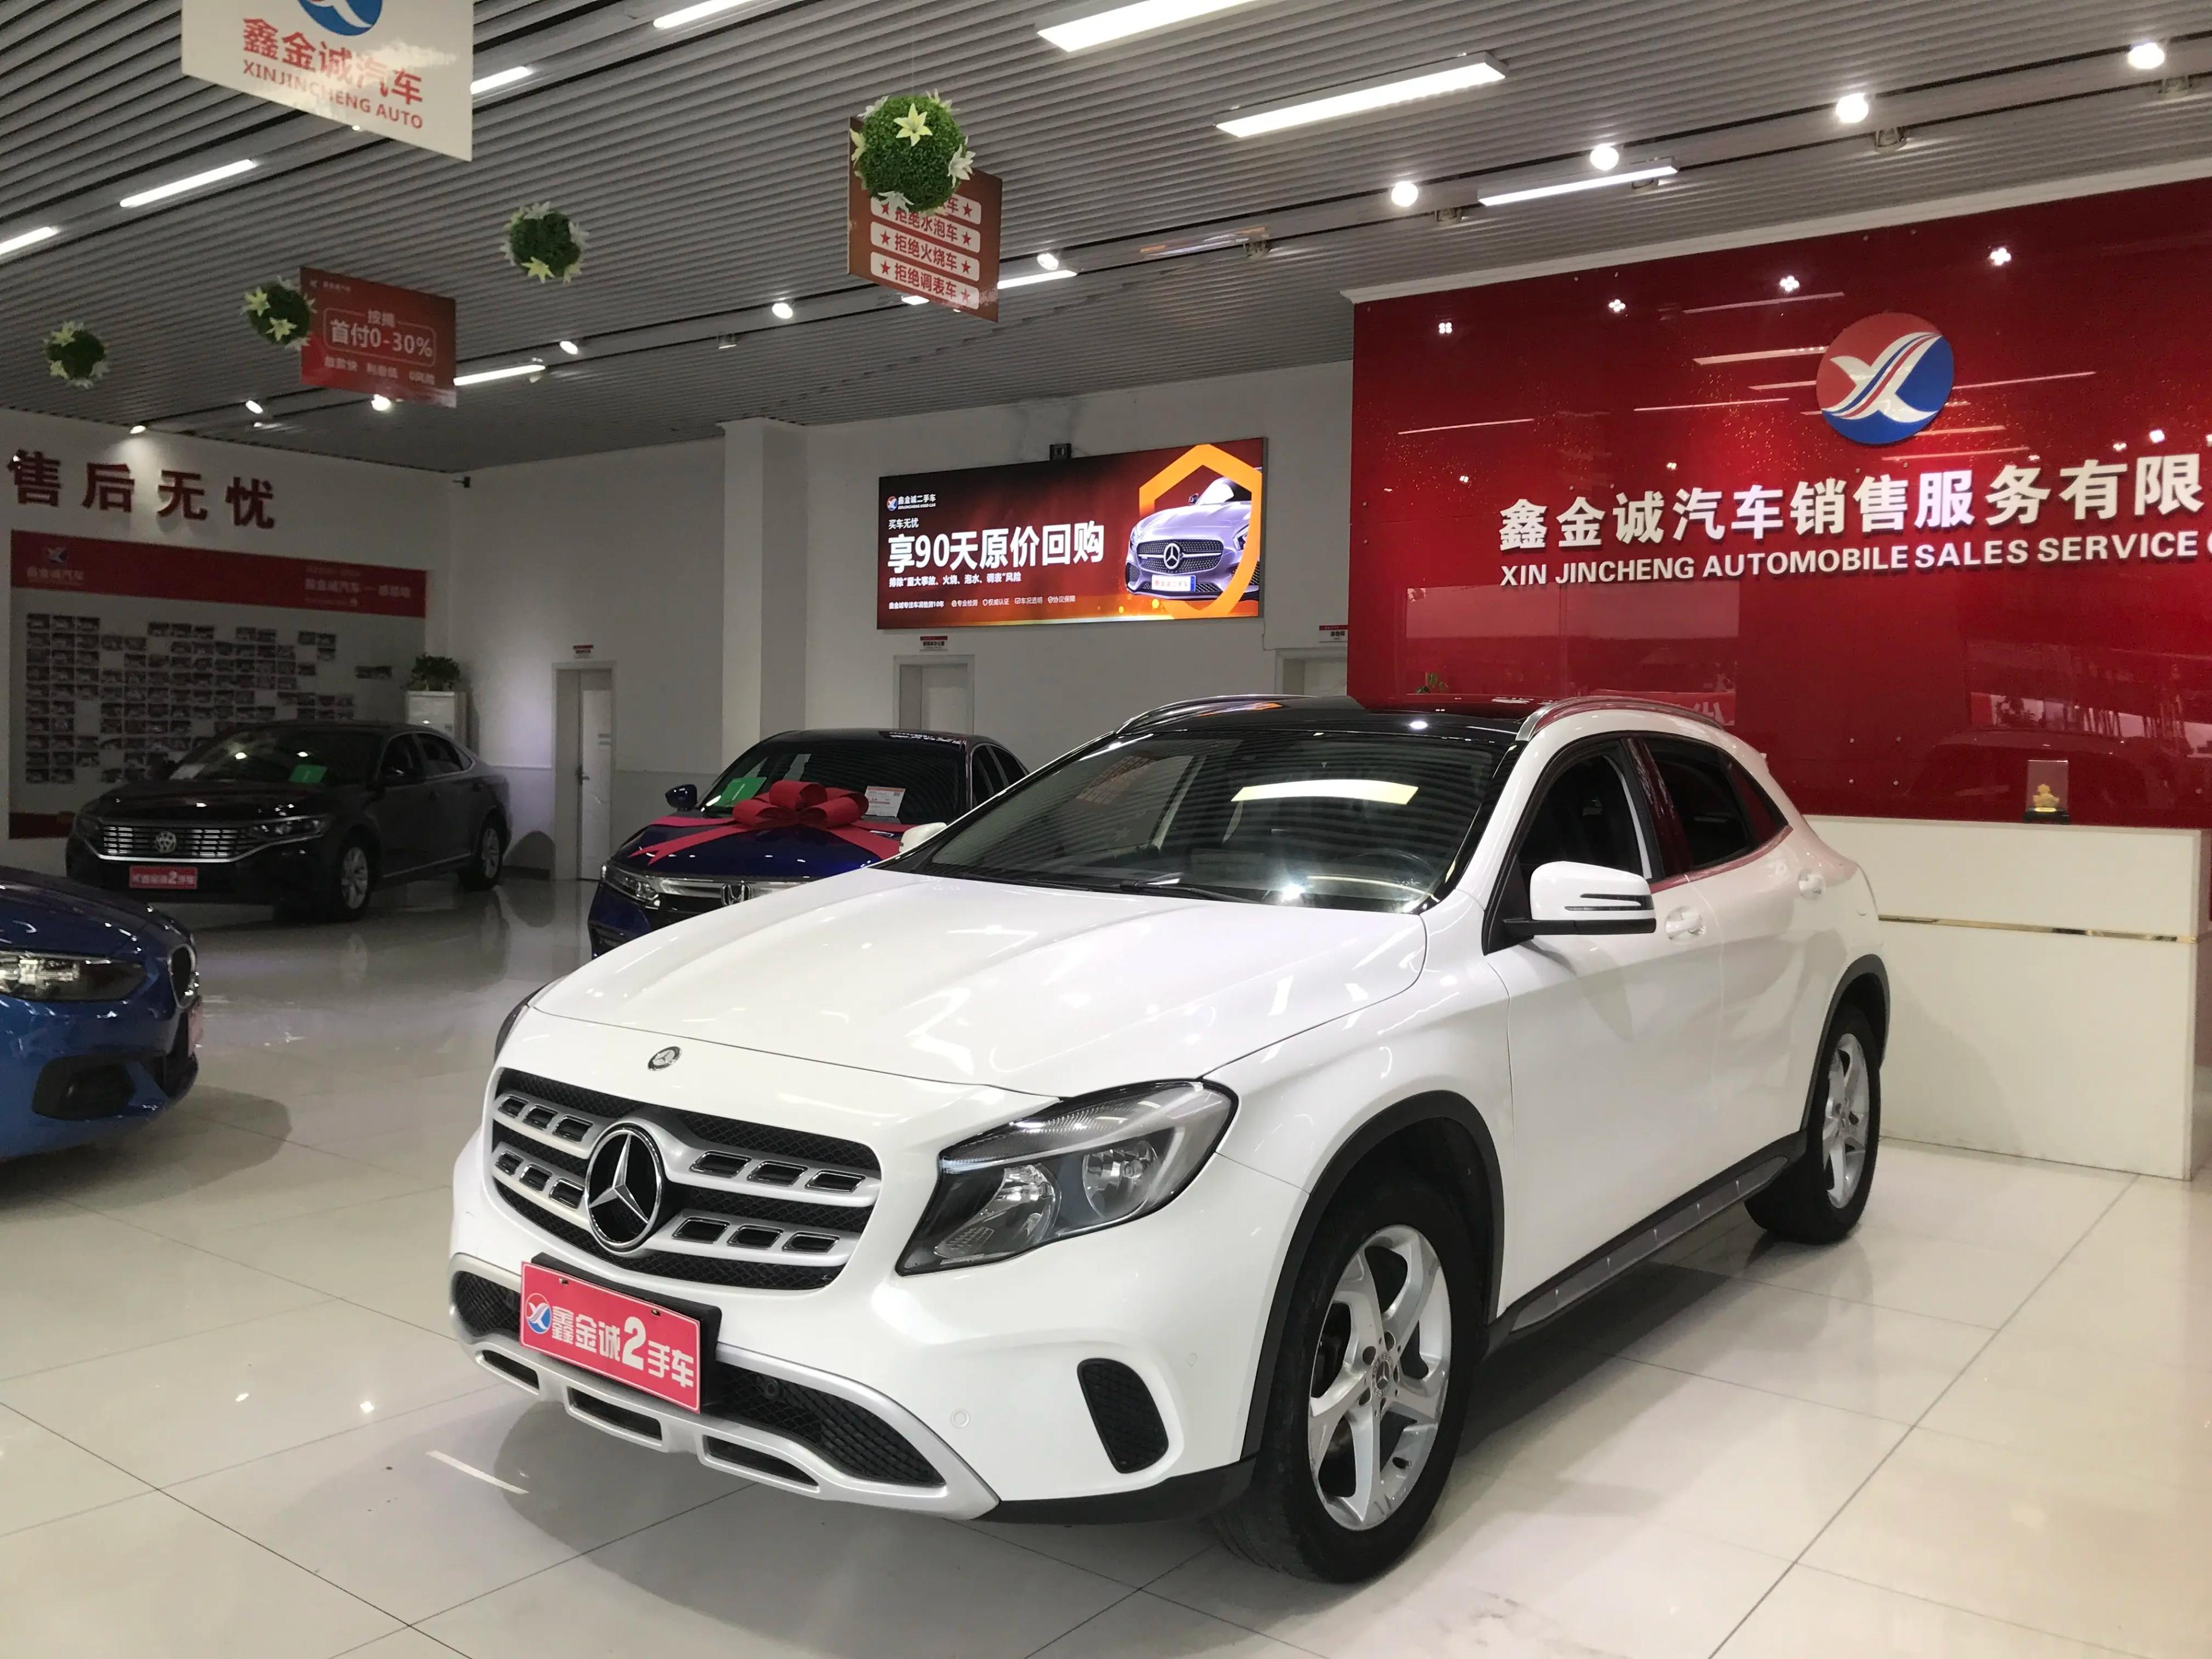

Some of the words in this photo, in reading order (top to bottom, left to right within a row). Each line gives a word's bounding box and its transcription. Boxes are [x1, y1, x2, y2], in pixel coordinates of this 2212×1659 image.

[243, 18, 423, 105] 鑫金诚汽车
[243, 59, 371, 113] XINJINCHENG
[376, 104, 423, 129] AUTO
[895, 233, 958, 271] 拒绝火烧车
[895, 263, 957, 298] 拒绝调表车
[331, 319, 433, 357] 首付0-30%
[7, 449, 275, 529] 售后无忧
[1498, 453, 2205, 551] 鑫金诚汽车销售服务有限
[888, 517, 919, 530] 买车无忧
[888, 520, 1104, 574] 享90天原价回购
[1499, 565, 1547, 586] XIN
[1555, 556, 1695, 585] JINCHENG
[1702, 545, 1908, 578] AUTOMOBILE
[1914, 539, 2029, 569] SALES
[2037, 531, 2199, 563] SERVICE
[551, 1305, 695, 1388] 鑫金诚2手车
